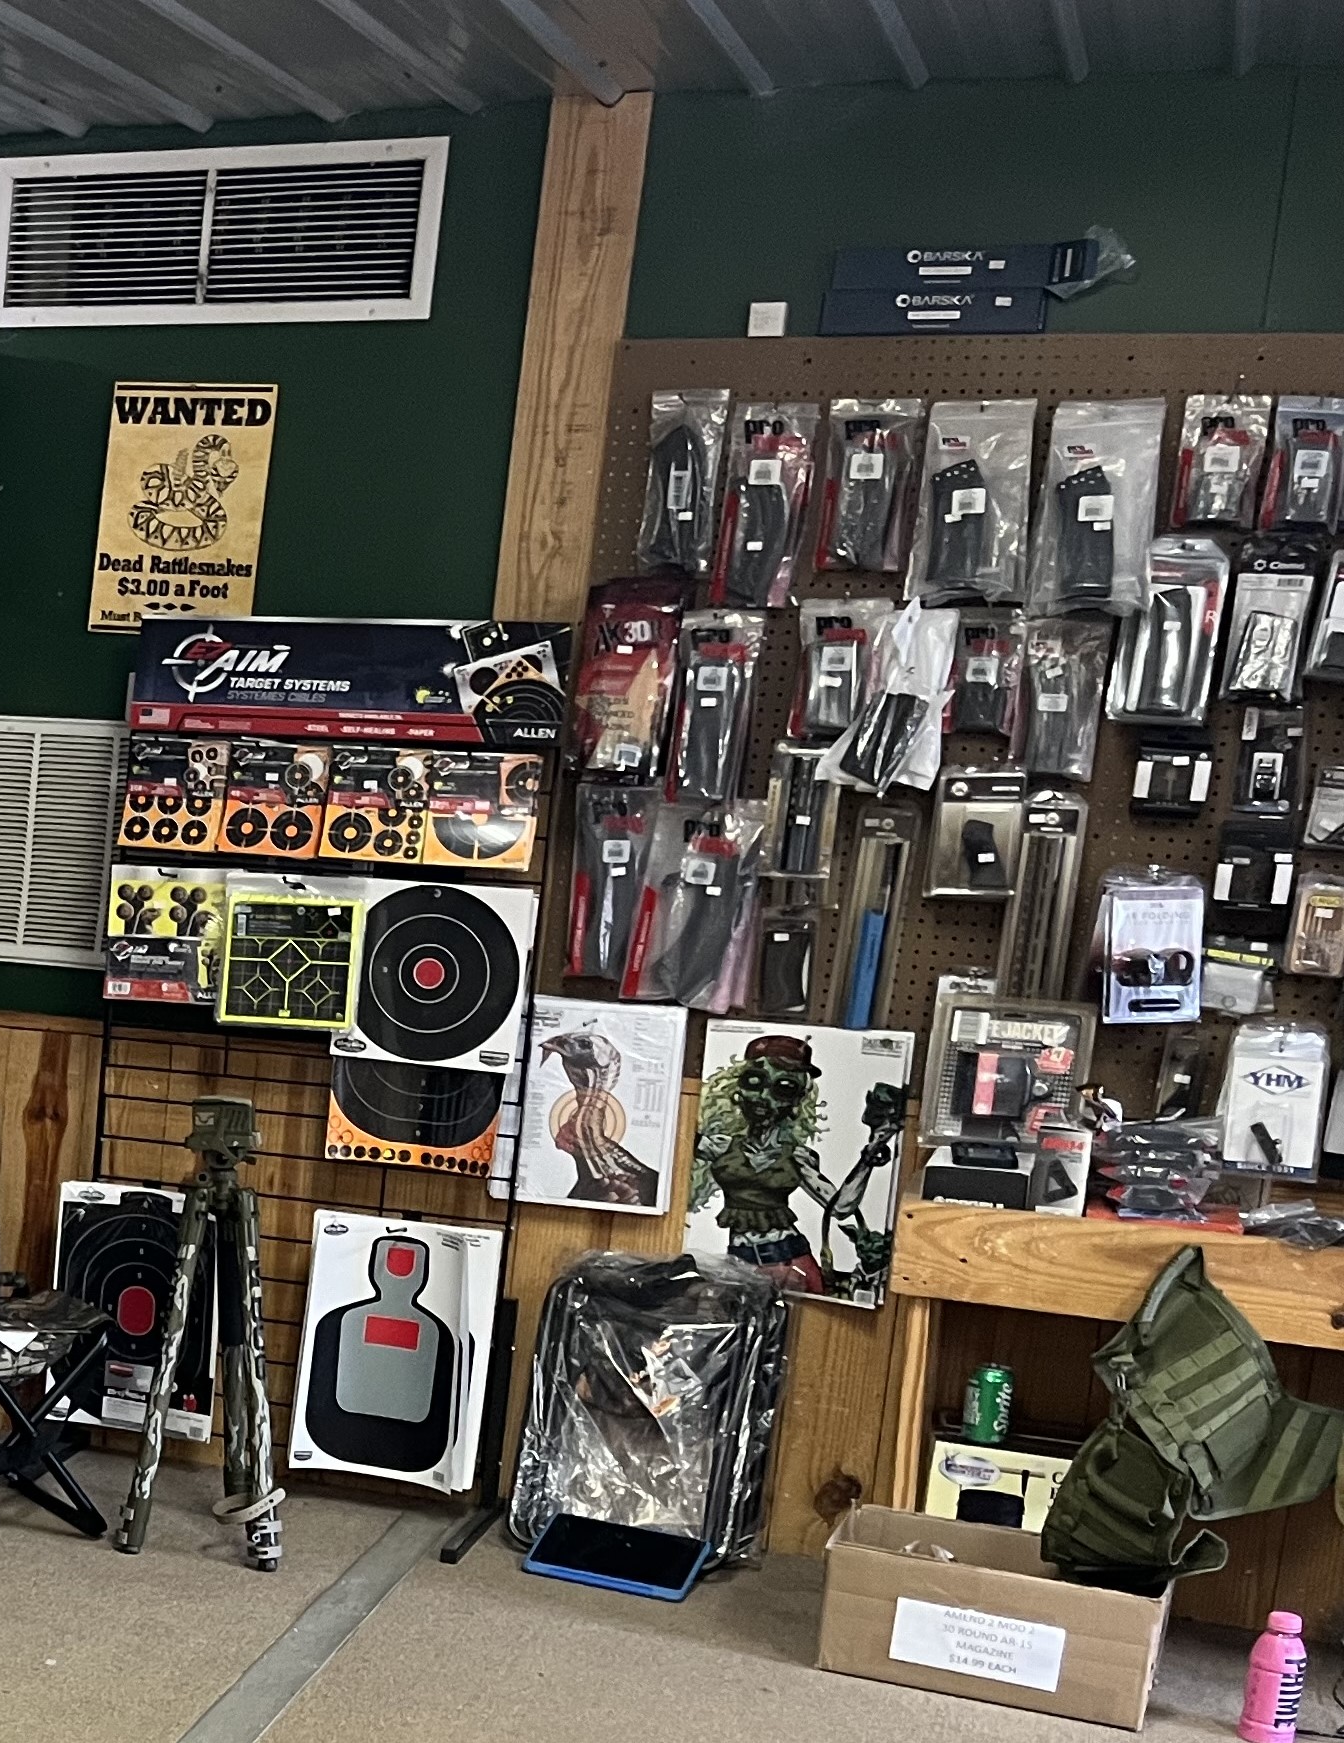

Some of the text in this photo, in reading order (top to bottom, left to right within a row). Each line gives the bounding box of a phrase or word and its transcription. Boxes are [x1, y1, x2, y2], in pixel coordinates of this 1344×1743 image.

[924, 252, 983, 263] BARSKA
[913, 296, 972, 306] BARSKA
[116, 396, 272, 427] WANTED
[99, 553, 252, 577] Dead Rattlesnakes
[118, 577, 229, 599] $3.00 a Foot
[101, 609, 130, 622] Must
[195, 648, 290, 682] AIM
[230, 677, 351, 693] TARGET SYSTEMS
[514, 727, 558, 740] ALLEN
[1250, 1071, 1304, 1089] YHM
[993, 1383, 1013, 1434] Sprite
[944, 1609, 986, 1626] AMEND
[988, 1618, 996, 1628] 2
[998, 1619, 1027, 1634] MOD
[943, 1624, 957, 1634] 30
[958, 1627, 999, 1643] ROUND
[956, 1640, 1014, 1659] MAGAZINE
[988, 1661, 1018, 1675] EACH
[1274, 1658, 1308, 1729] PRIME
